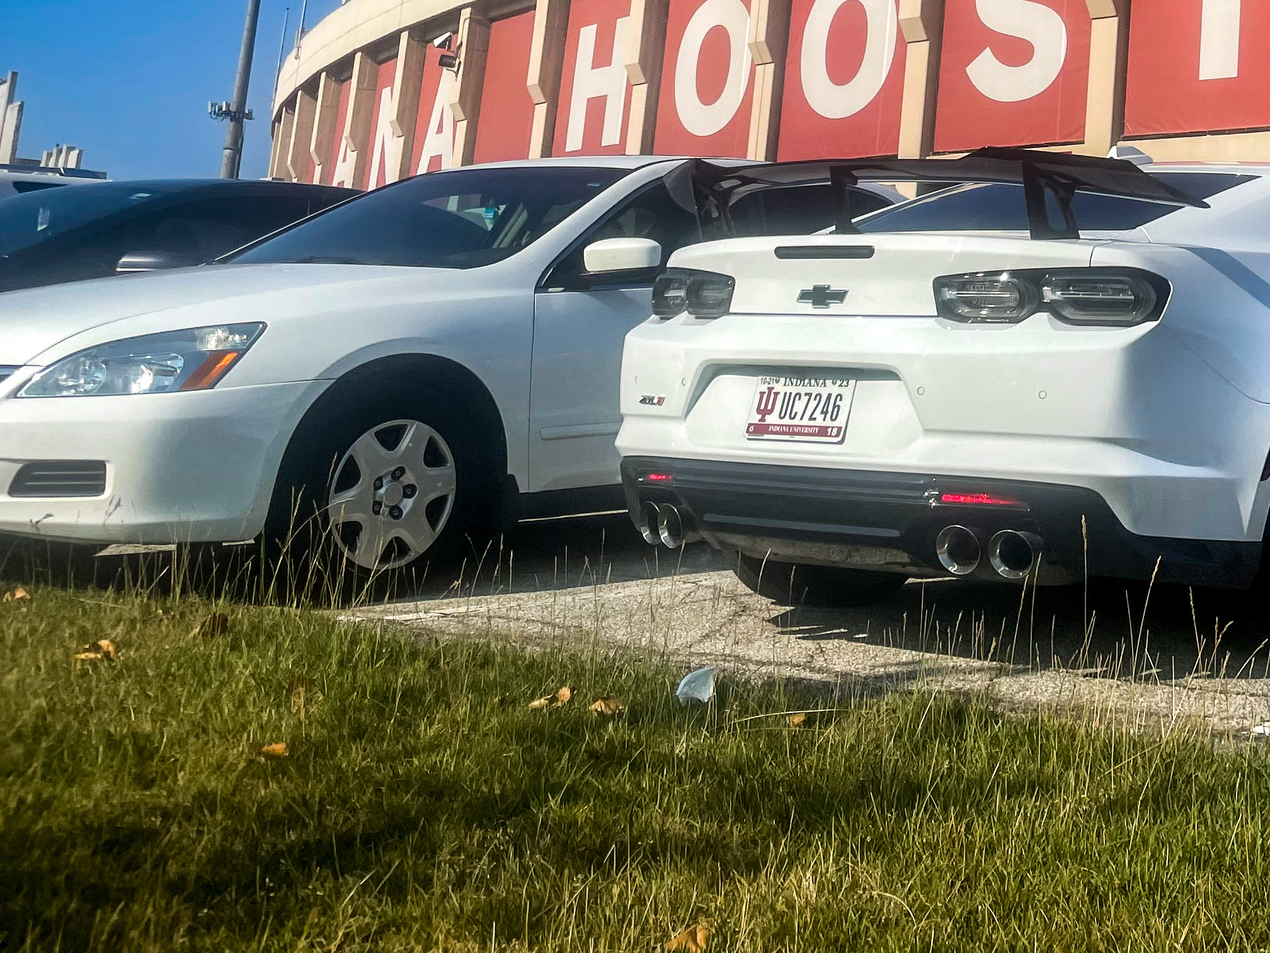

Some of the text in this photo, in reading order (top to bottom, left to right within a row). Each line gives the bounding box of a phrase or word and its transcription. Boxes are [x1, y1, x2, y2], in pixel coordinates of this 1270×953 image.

[783, 377, 827, 388] INDIANA
[778, 391, 843, 422] UC7246
[826, 427, 838, 436] 18
